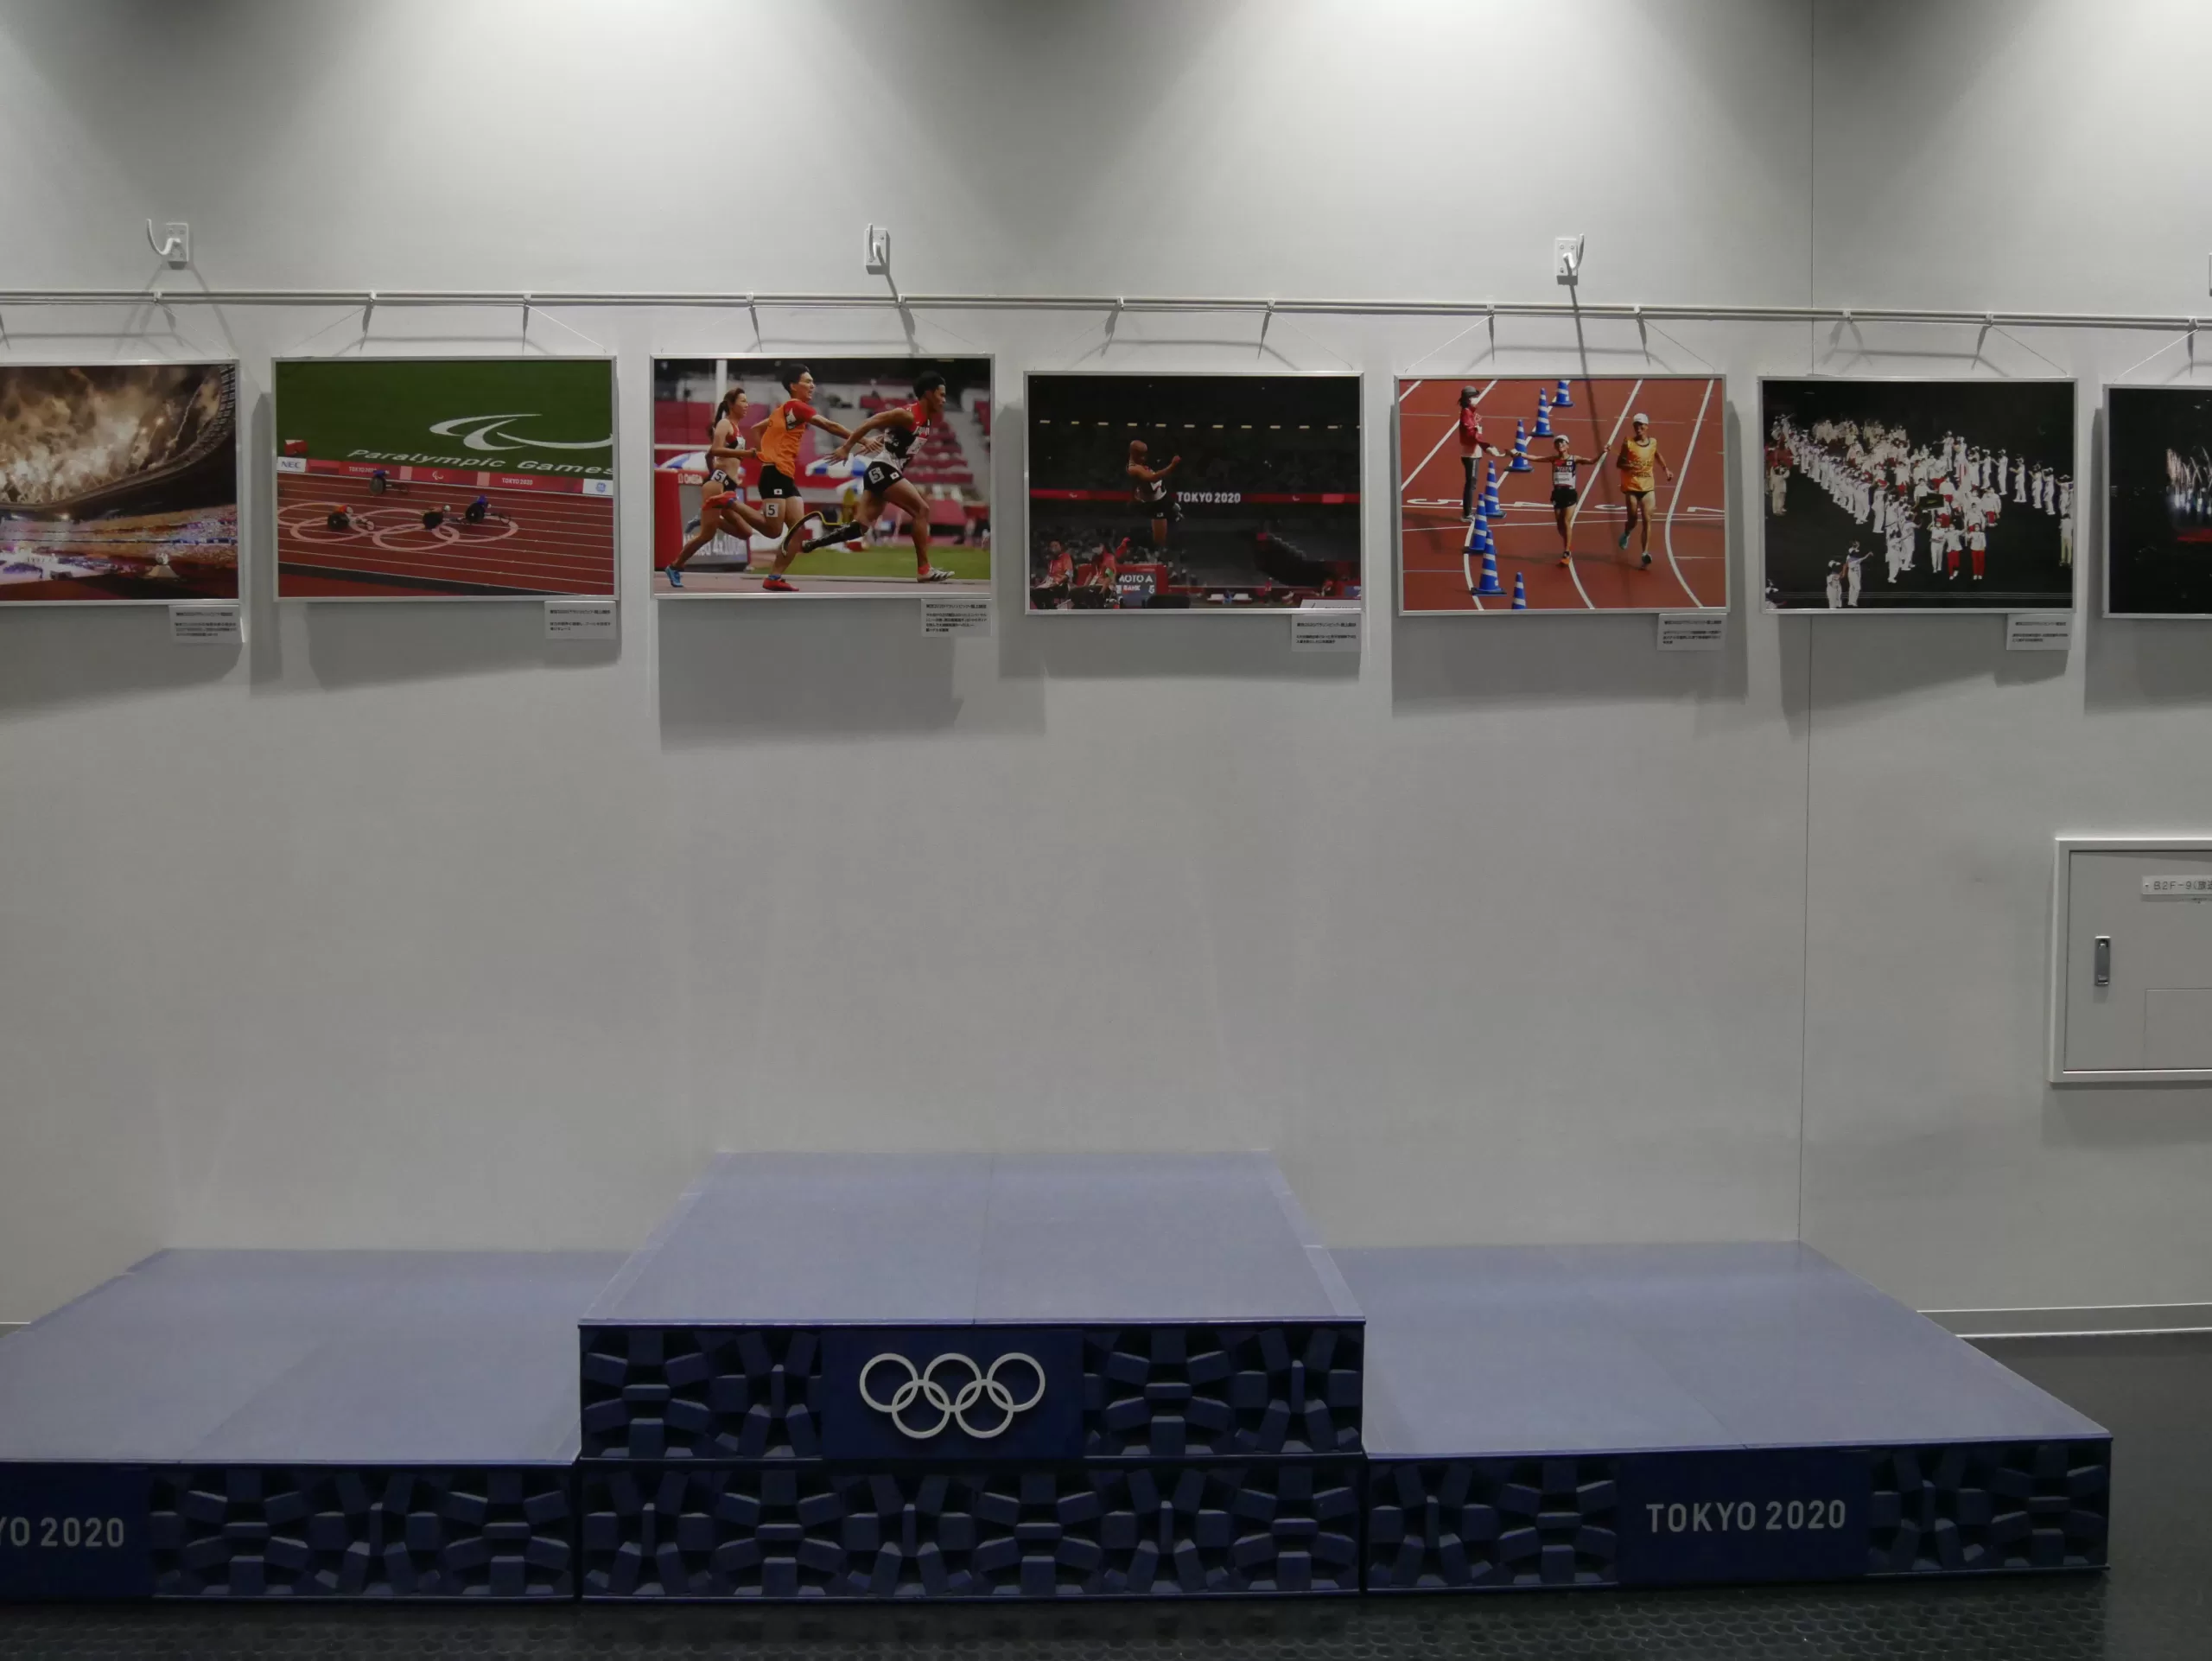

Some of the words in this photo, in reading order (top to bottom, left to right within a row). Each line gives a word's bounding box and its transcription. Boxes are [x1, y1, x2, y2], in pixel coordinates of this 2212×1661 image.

[281, 460, 301, 469] NEC
[347, 449, 506, 469] Paralympic
[517, 460, 613, 476] Games
[714, 471, 723, 481] 5
[871, 469, 880, 480] 5
[1176, 491, 1213, 503] TOKYO
[1213, 493, 1242, 505] 2020
[767, 504, 776, 516] 5
[1646, 1501, 1756, 1533] TOKYO
[1765, 1499, 1846, 1531] 2020
[40, 1517, 124, 1548] 2020
